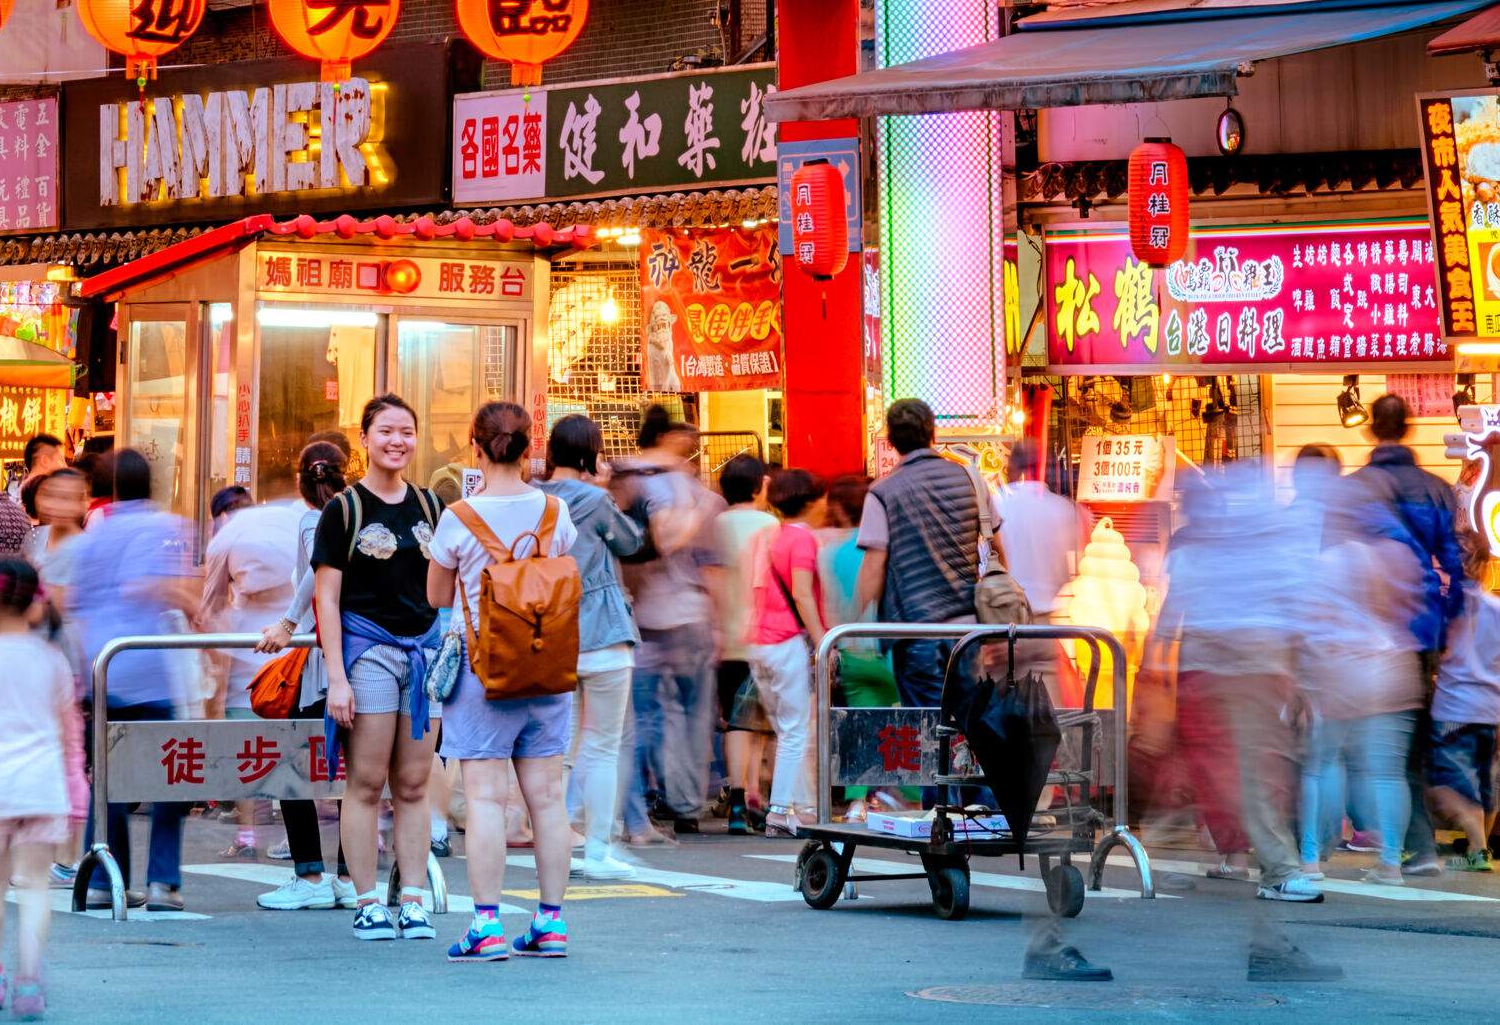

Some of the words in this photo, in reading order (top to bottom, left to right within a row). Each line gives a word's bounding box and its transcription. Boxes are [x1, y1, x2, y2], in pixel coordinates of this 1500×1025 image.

[100, 76, 388, 208] HAMMER
[461, 112, 542, 179] 各國名藥
[438, 261, 526, 297] 服務台
[1054, 253, 1161, 354] 松鶴
[686, 299, 782, 344] 最佳伴手
[1165, 306, 1285, 359] 台港日料理
[235, 446, 252, 492] 請靠
